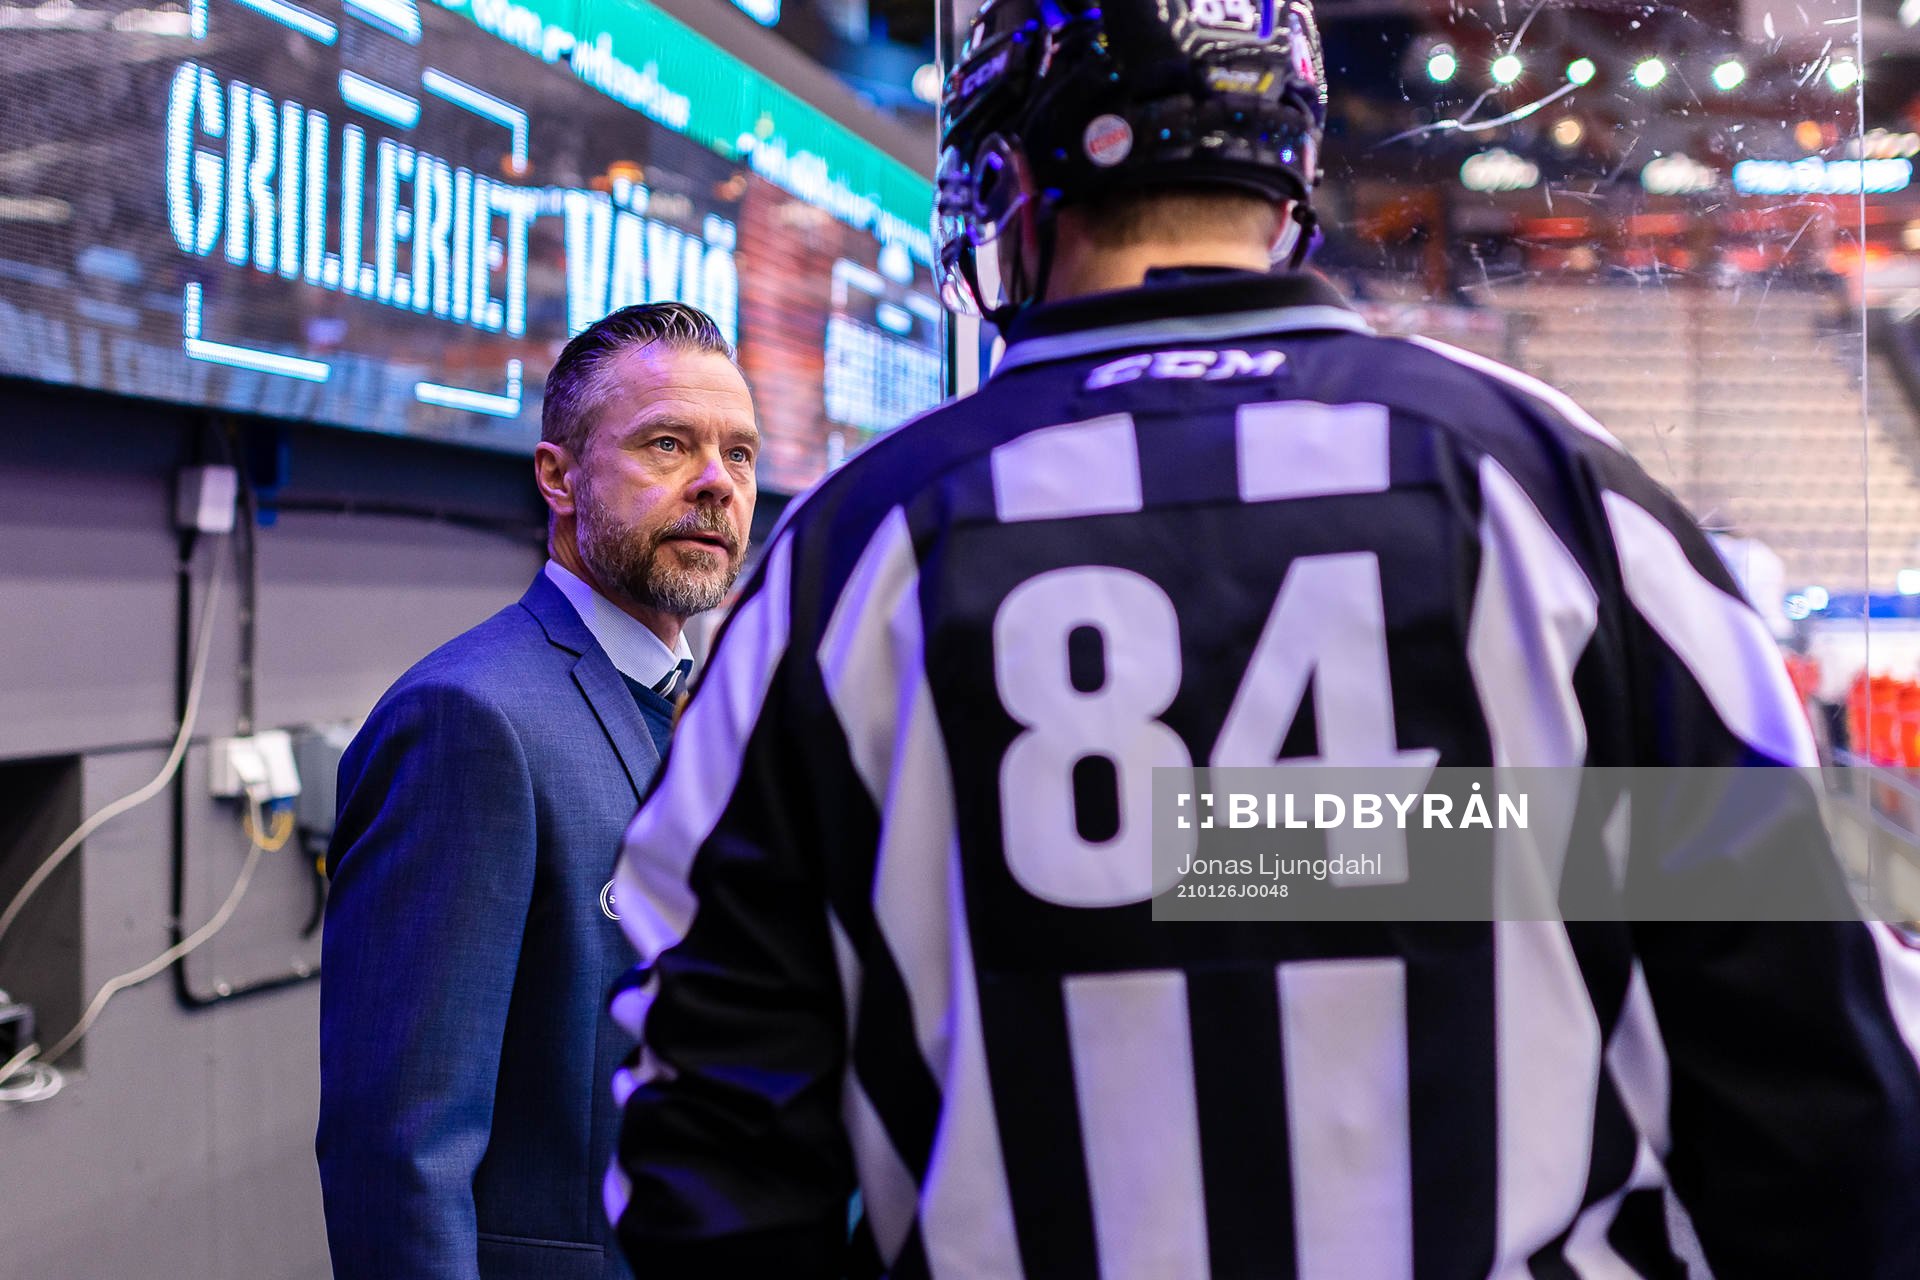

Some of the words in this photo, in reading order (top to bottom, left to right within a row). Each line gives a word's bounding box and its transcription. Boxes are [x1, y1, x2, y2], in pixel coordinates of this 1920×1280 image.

[165, 60, 538, 339] GRILLERIET
[1084, 349, 1286, 390] CCM
[992, 551, 1441, 909] 84
